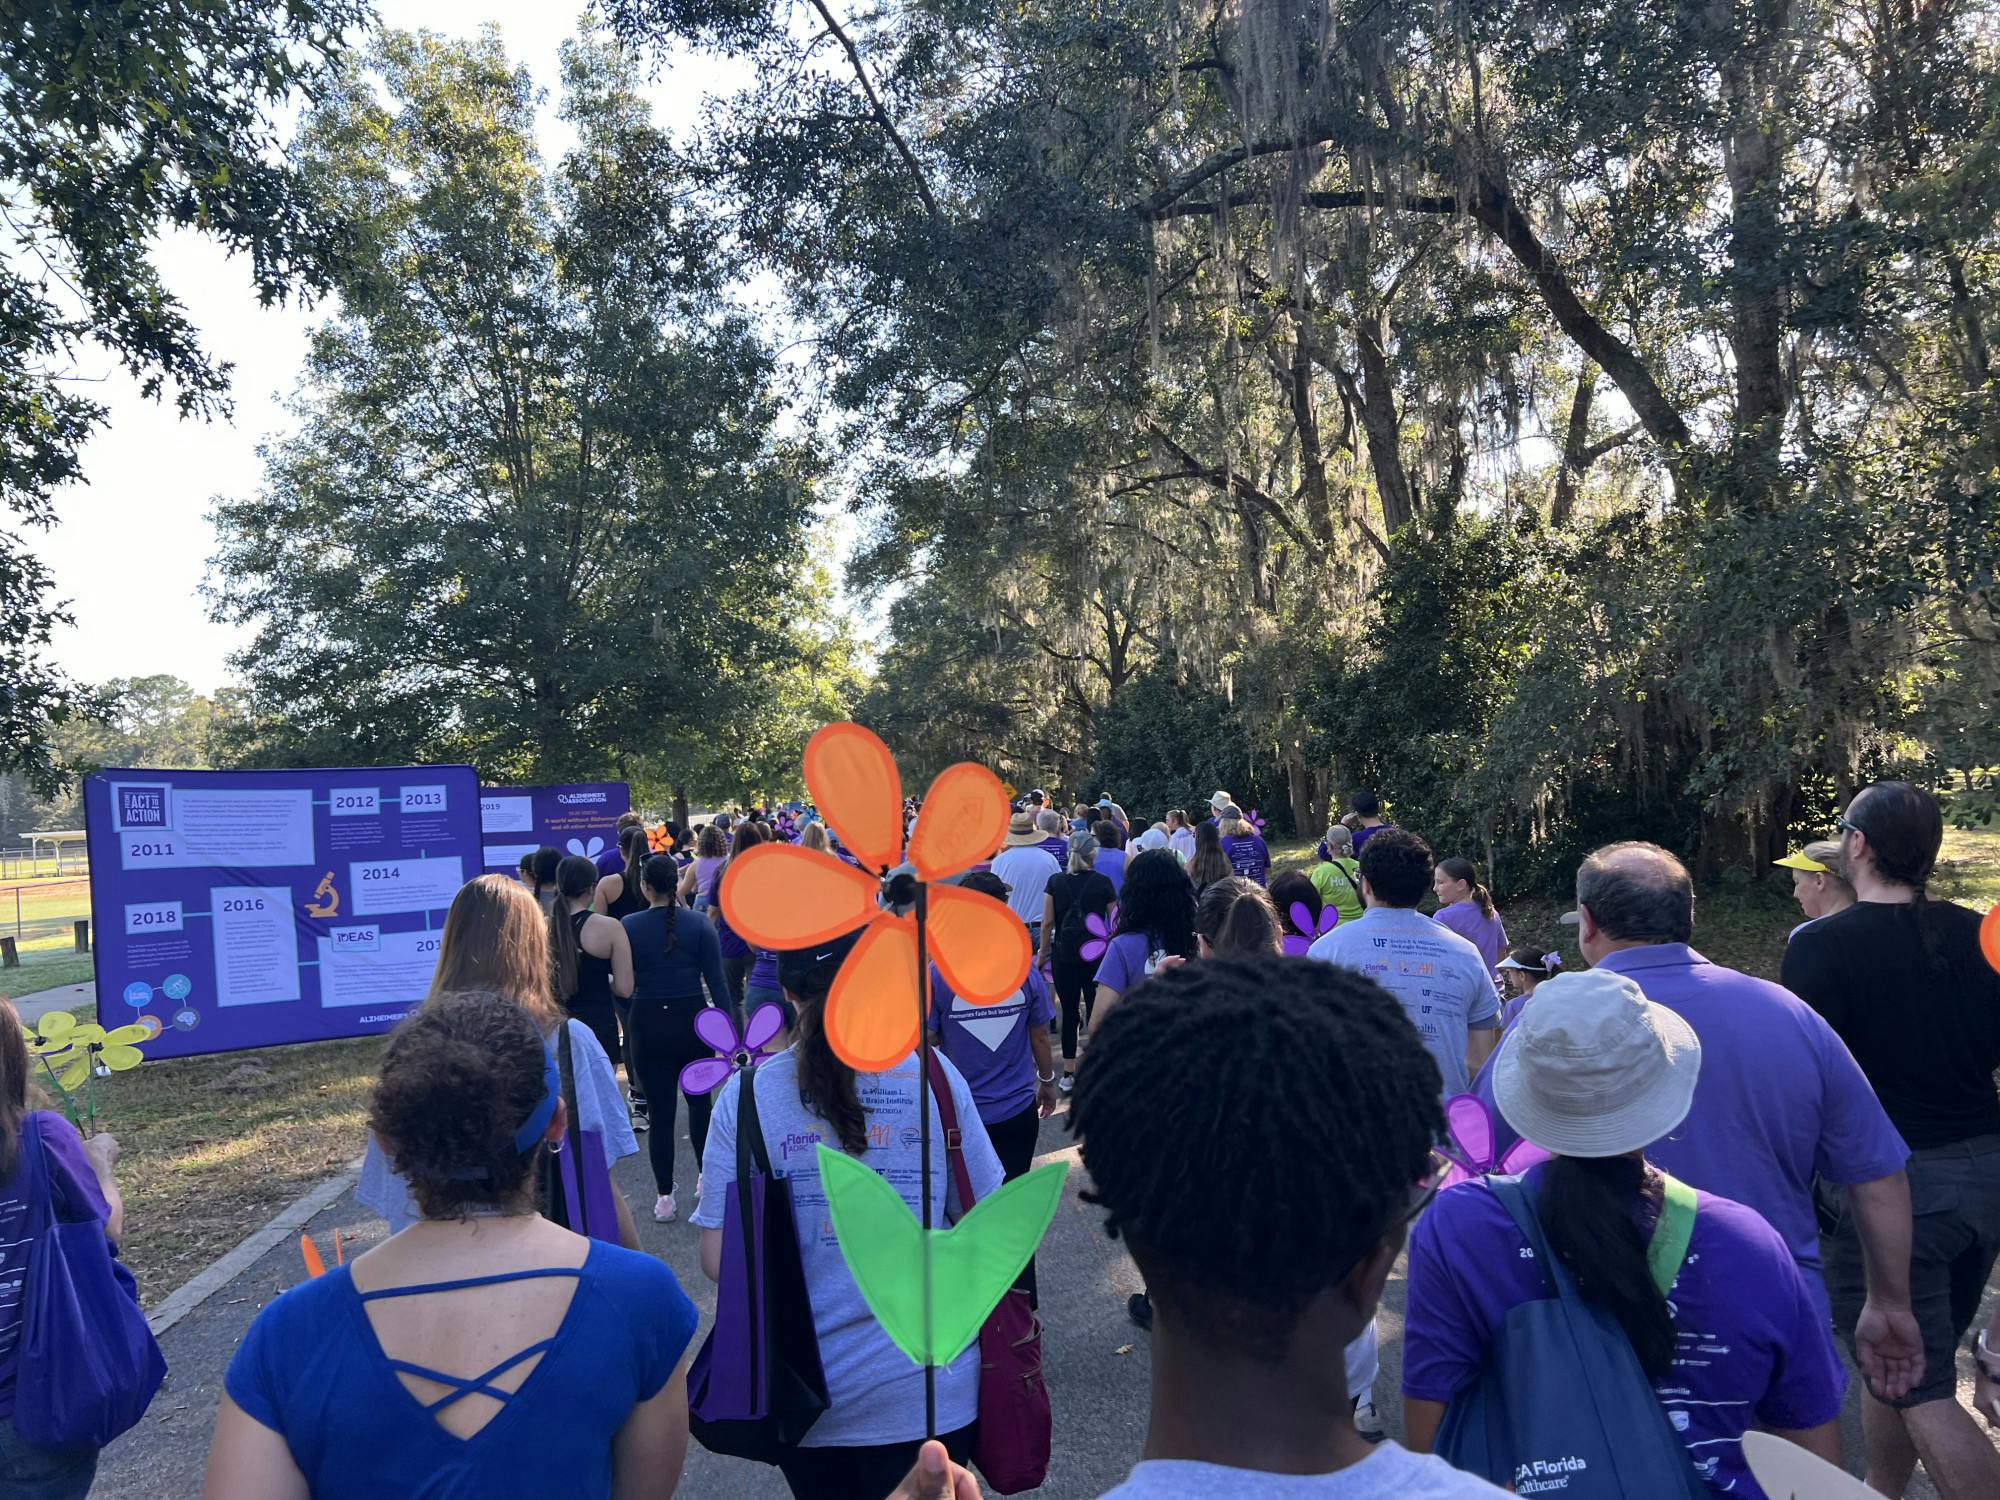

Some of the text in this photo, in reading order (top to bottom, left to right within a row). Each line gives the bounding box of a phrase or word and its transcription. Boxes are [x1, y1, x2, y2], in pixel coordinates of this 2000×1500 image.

[131, 794, 150, 809] ACT
[336, 796, 375, 808] 2012
[405, 793, 442, 806] 2013
[126, 809, 160, 822] ACTION
[131, 844, 174, 856] 2011
[362, 867, 400, 880] 2014
[223, 899, 264, 912] 2016
[132, 910, 176, 926] 2018
[416, 940, 442, 952] 201
[1372, 938, 1388, 948] UF
[1422, 1004, 1432, 1014] UF
[786, 1132, 821, 1144] Florida
[1516, 1456, 1586, 1480] CA Florida
[1520, 1477, 1569, 1494] althcare
